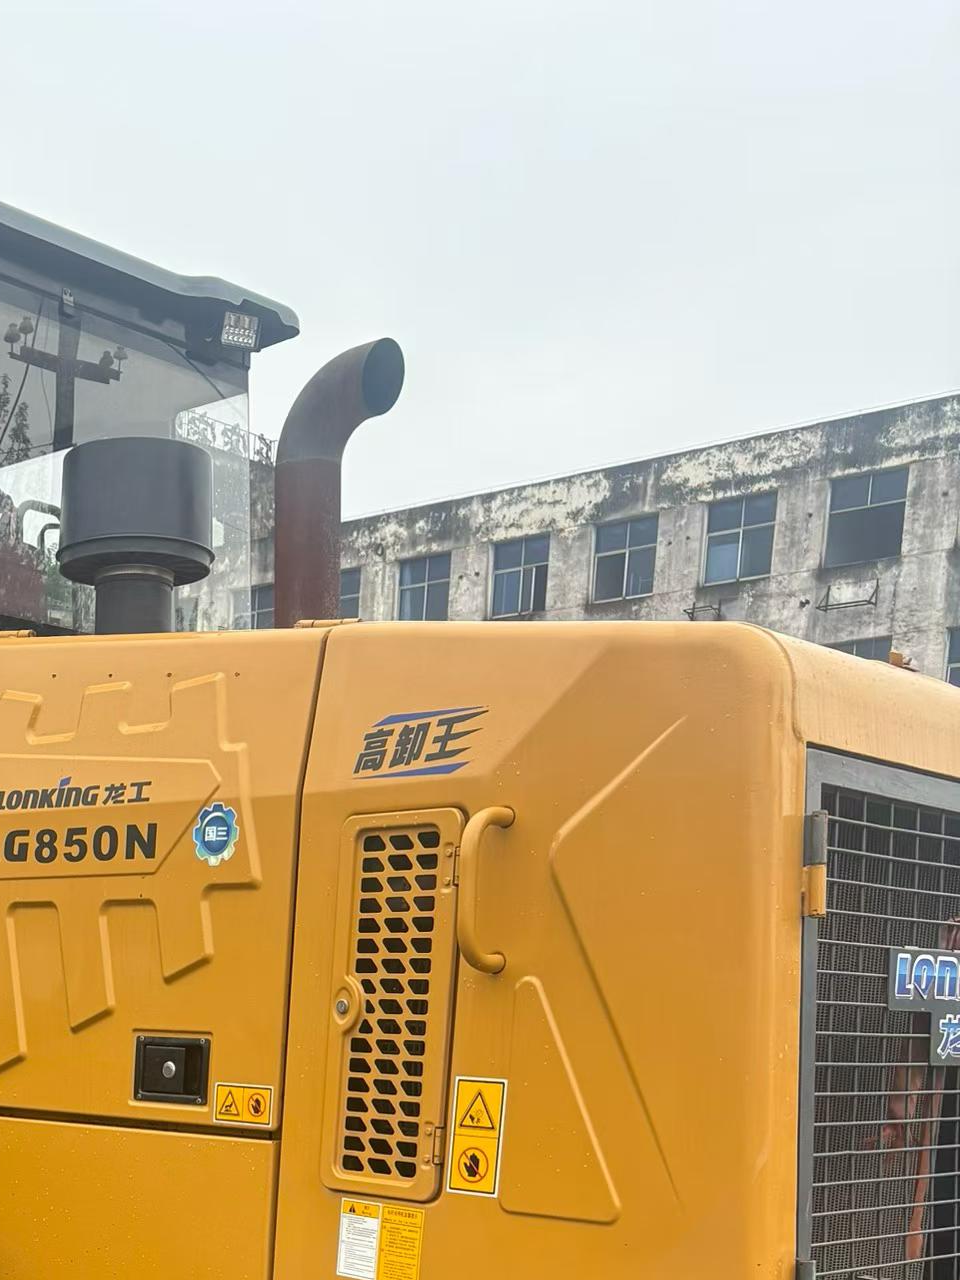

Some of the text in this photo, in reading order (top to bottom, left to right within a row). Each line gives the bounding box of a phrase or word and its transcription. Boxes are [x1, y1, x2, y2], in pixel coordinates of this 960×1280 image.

[353, 709, 489, 774] 高卸王
[102, 780, 152, 806] 龙工
[204, 825, 229, 842] 国三
[895, 952, 960, 1001] LON
